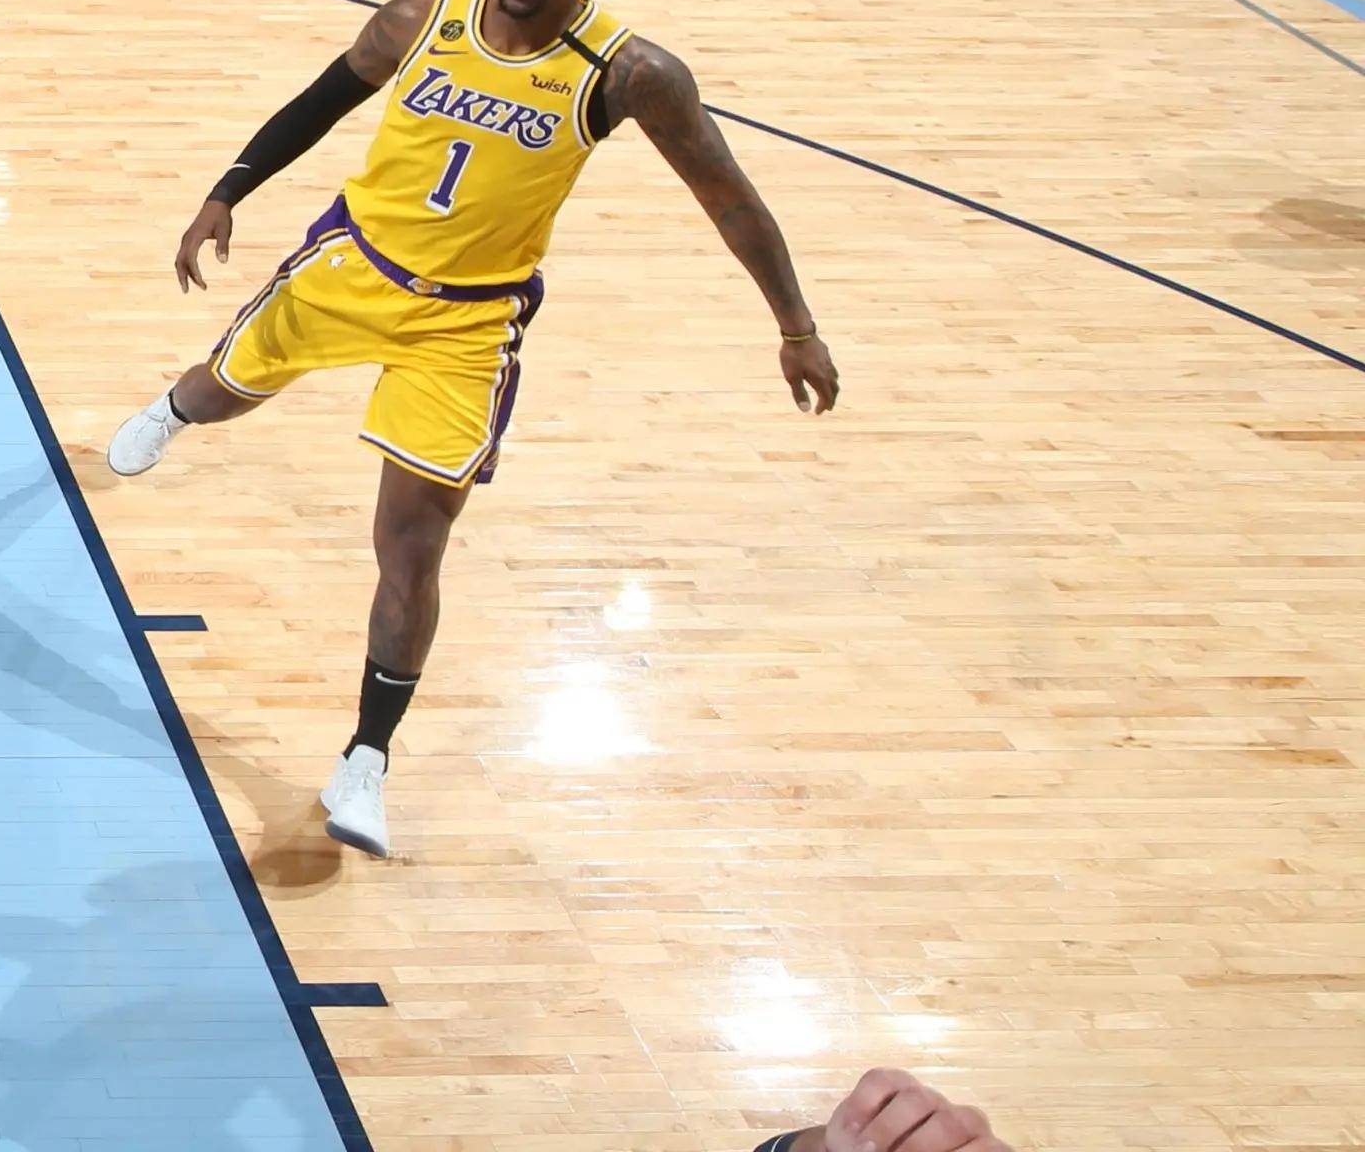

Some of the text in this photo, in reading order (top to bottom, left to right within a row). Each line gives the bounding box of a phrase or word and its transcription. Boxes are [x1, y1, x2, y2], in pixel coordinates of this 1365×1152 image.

[402, 66, 562, 149] LAKERS
[531, 73, 573, 96] wish
[426, 139, 474, 214] 1
